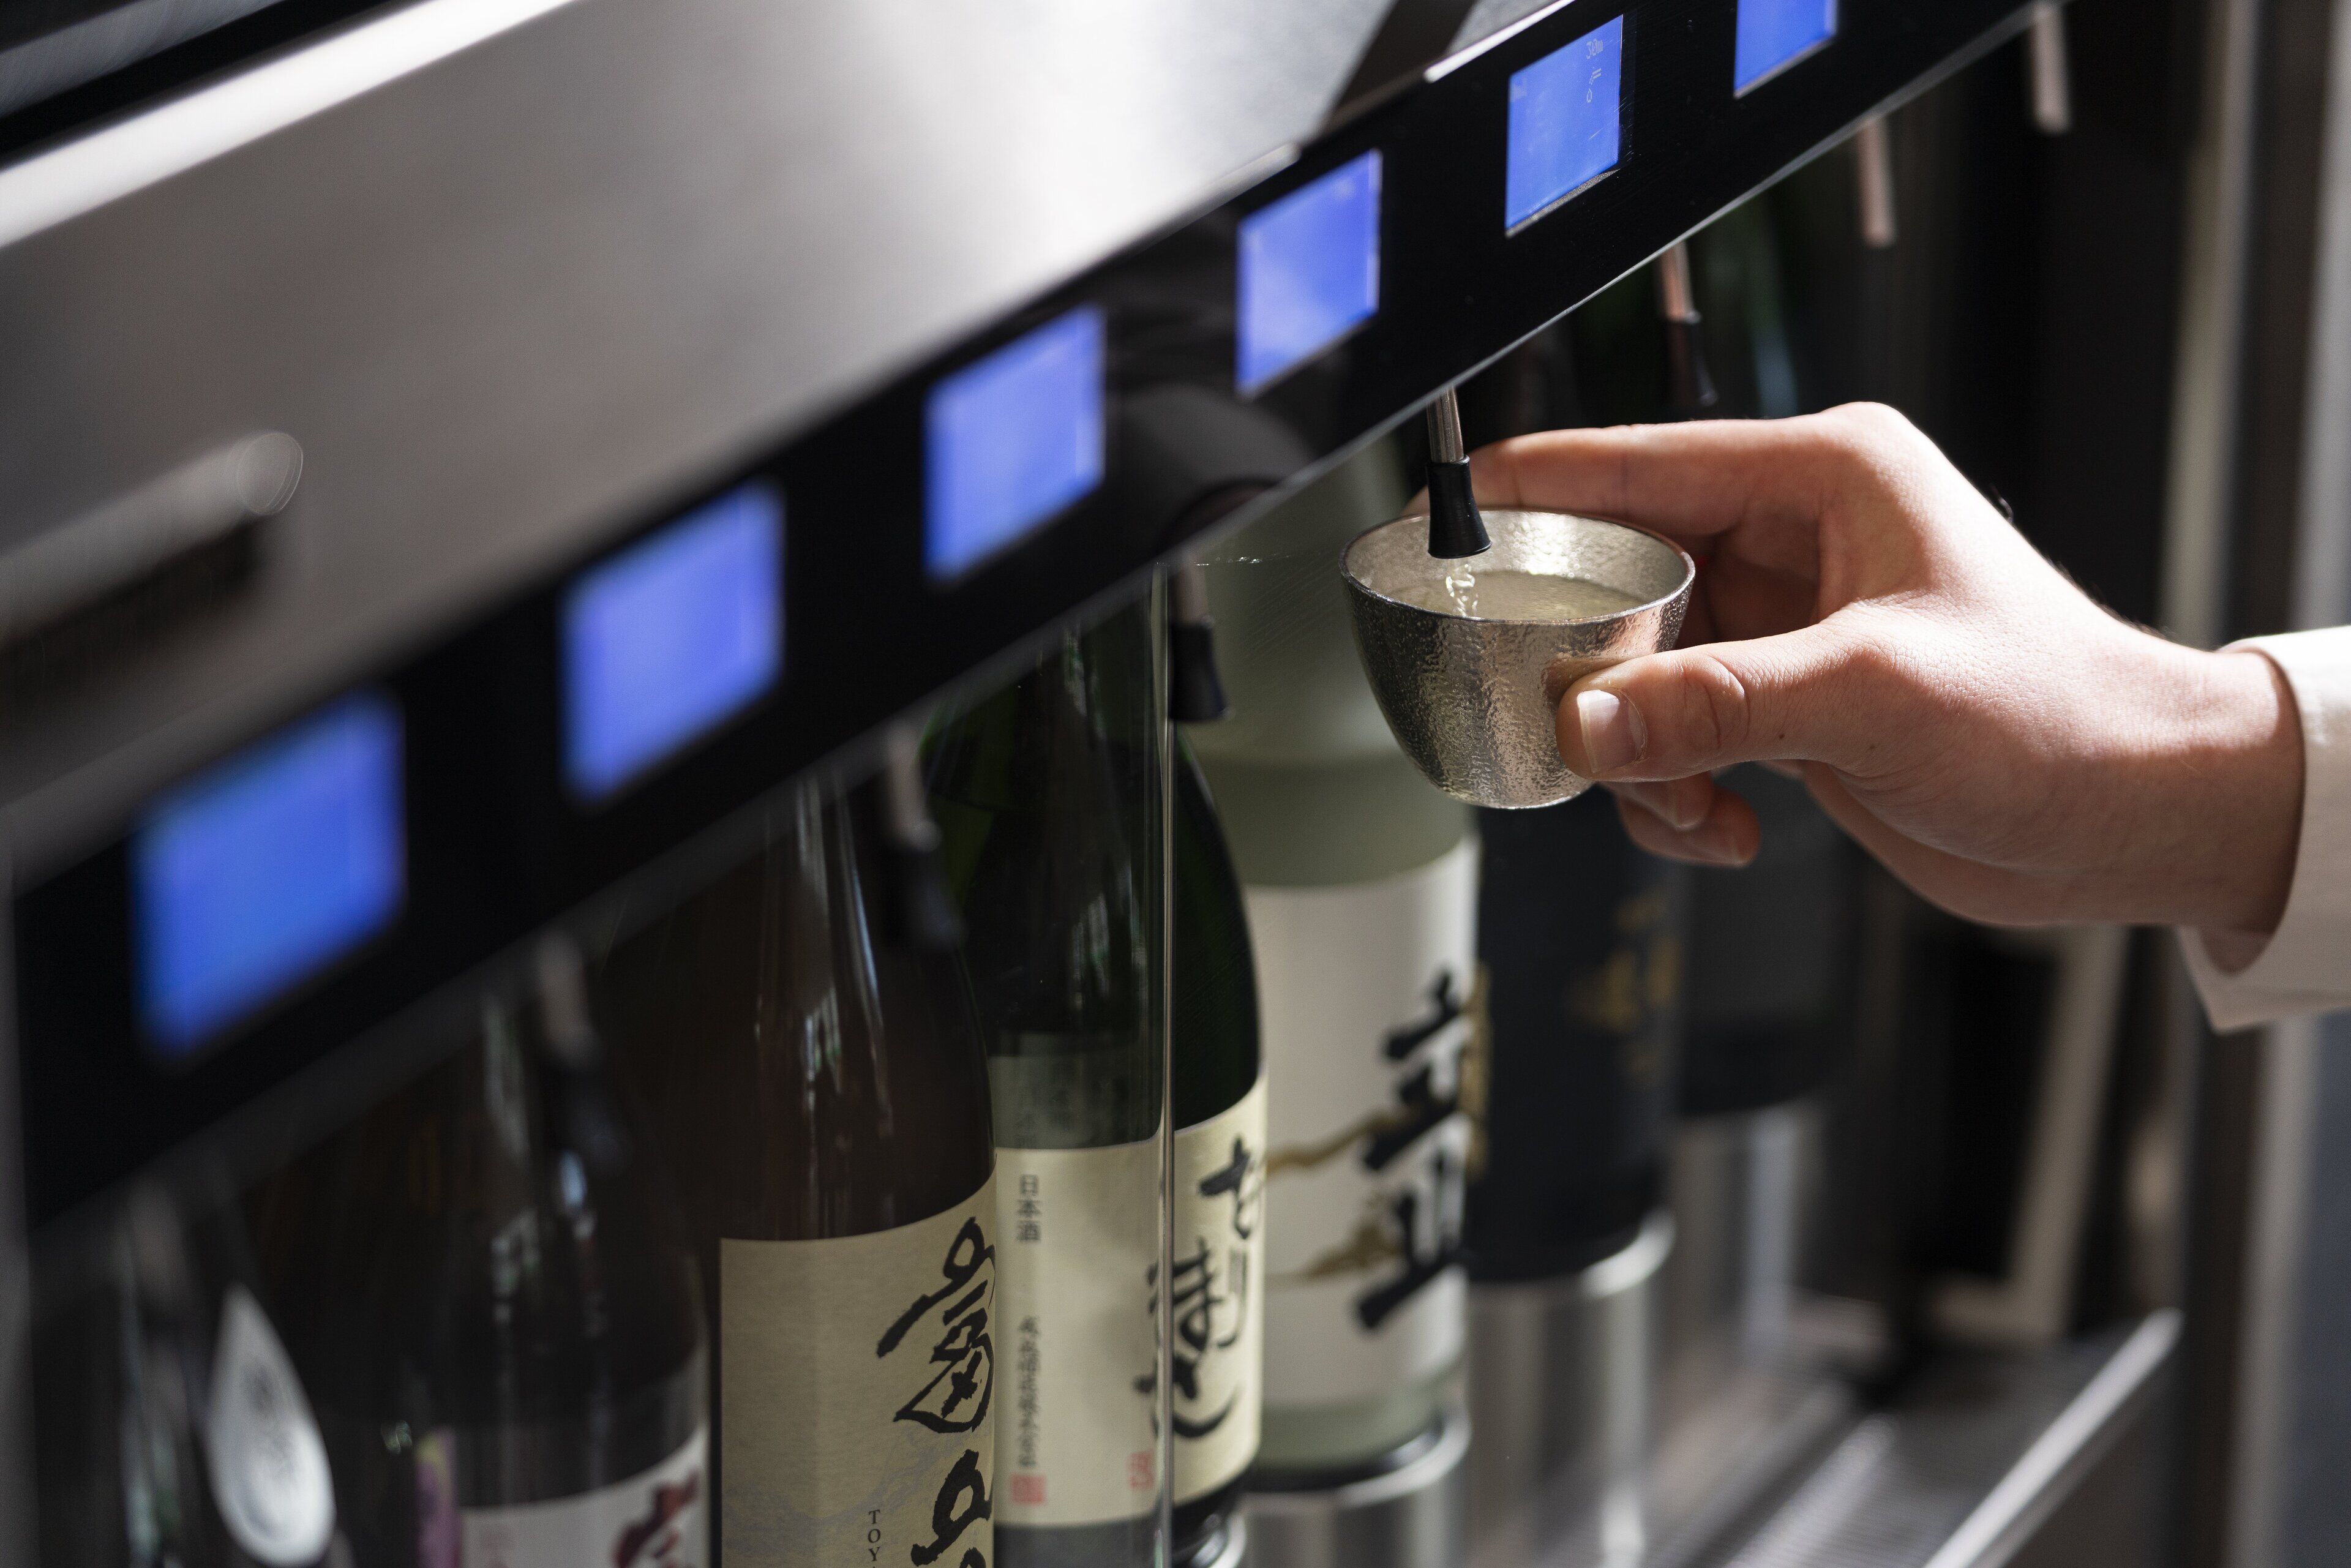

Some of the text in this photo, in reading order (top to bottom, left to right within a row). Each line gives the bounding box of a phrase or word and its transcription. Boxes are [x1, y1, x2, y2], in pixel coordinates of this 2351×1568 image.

[1018, 1175, 1042, 1243] 日本酒
[868, 1509, 881, 1568] TOY
